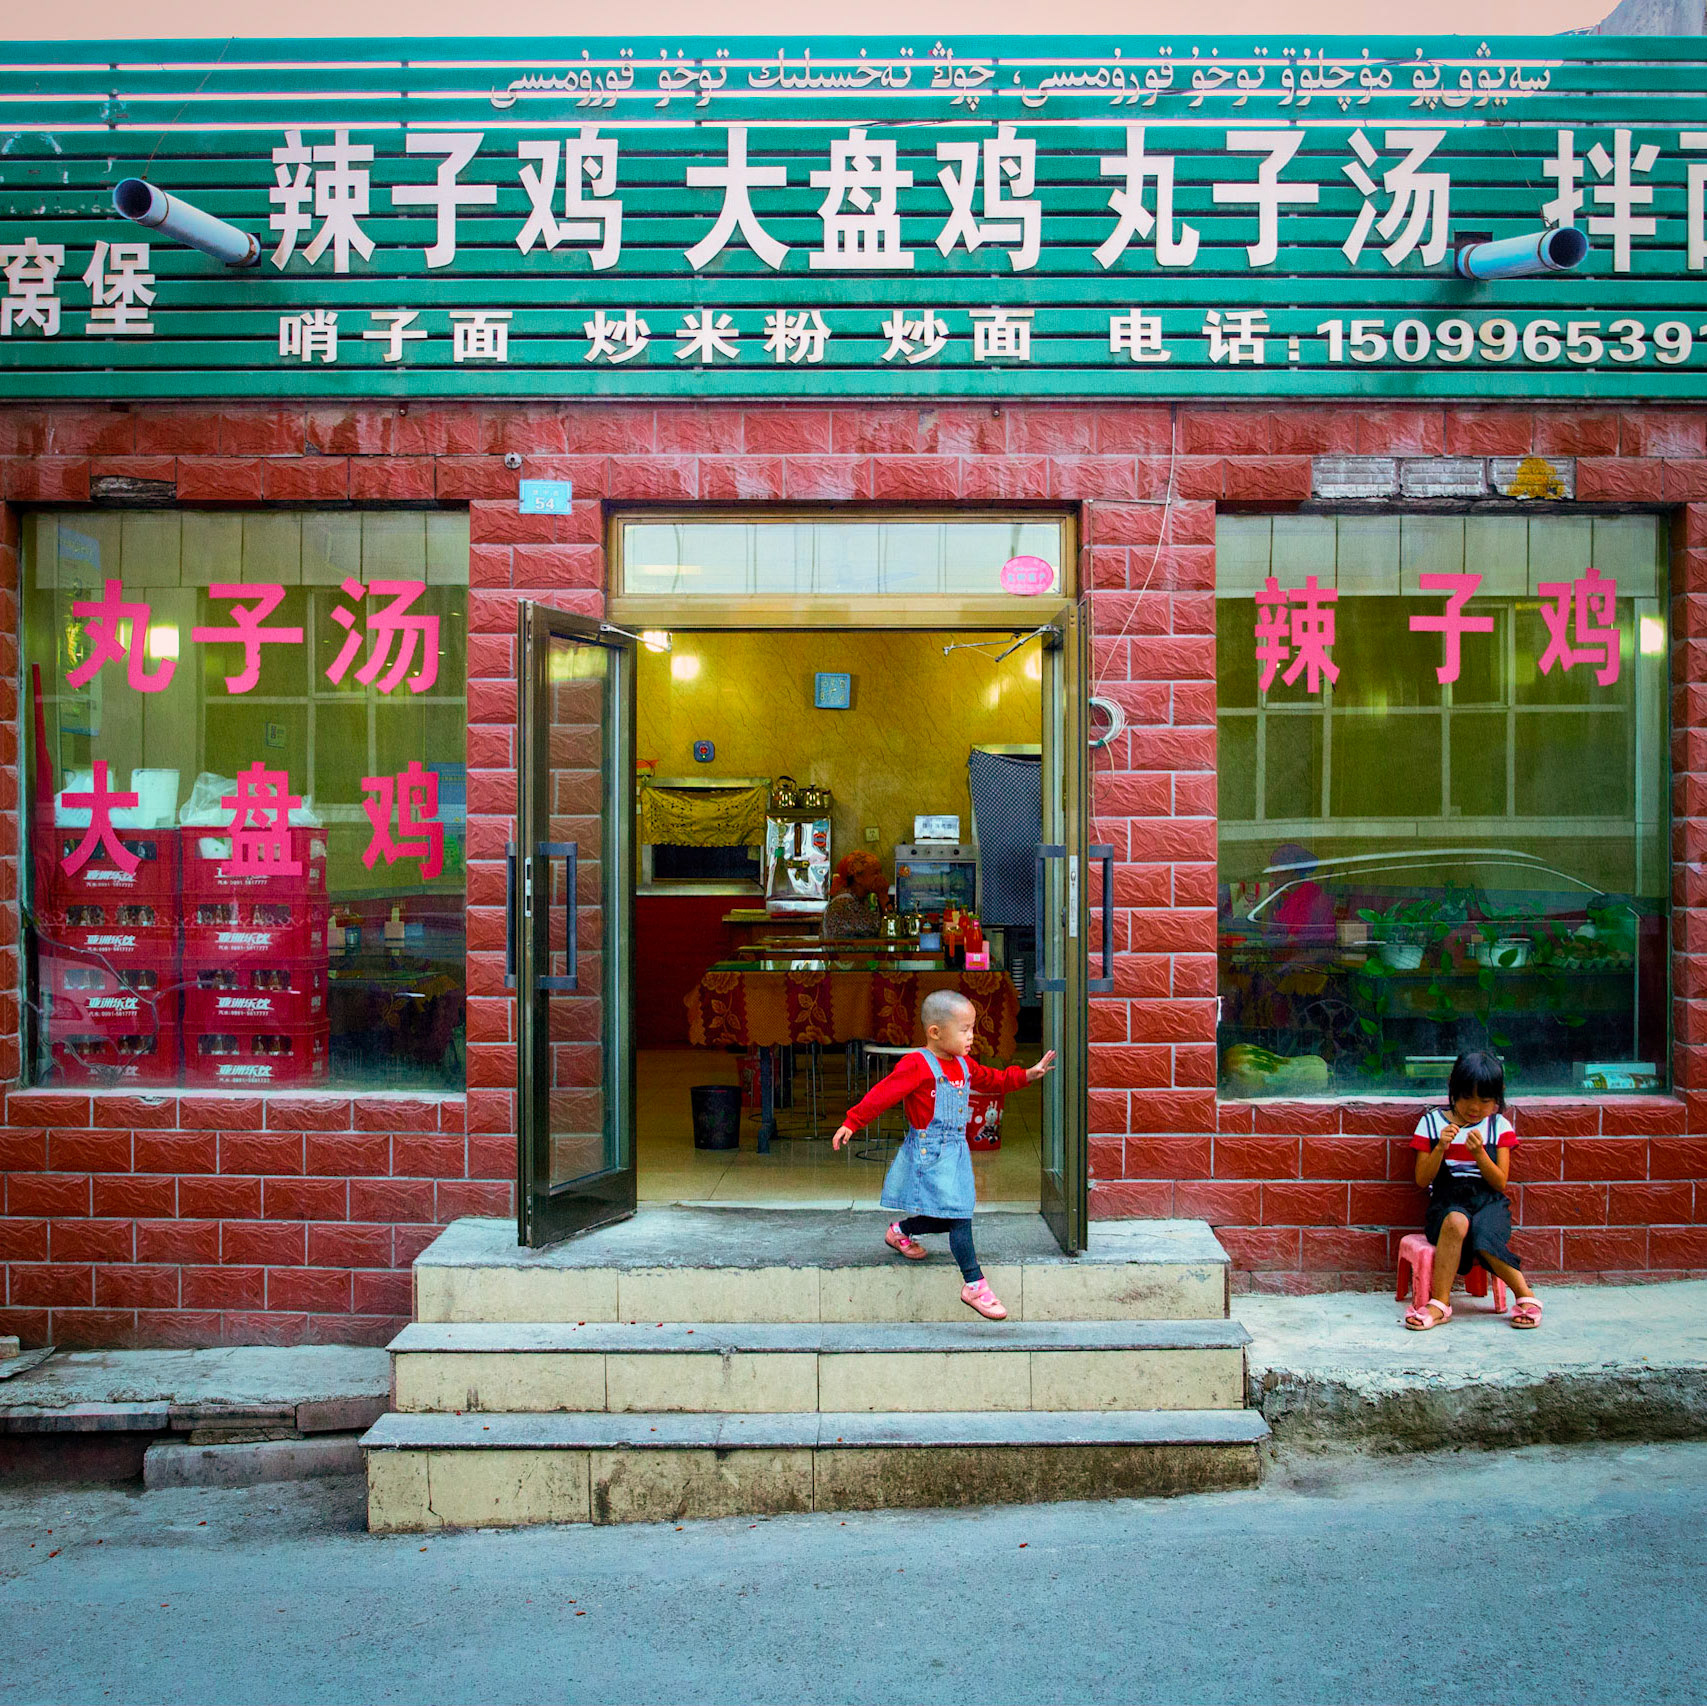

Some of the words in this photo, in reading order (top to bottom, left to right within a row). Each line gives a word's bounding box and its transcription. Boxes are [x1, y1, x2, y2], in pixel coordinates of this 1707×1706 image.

[269, 126, 622, 272] 辣子鸡
[684, 127, 1042, 272] 大盘鸡
[1092, 127, 1450, 271] 丸子汤
[1543, 129, 1707, 272] 拌
[0, 237, 157, 336] 窝堡
[280, 309, 513, 364] 哨子面
[583, 308, 832, 364] 炒米粉
[882, 308, 1034, 364] 炒面
[535, 496, 555, 511] 54
[66, 577, 440, 694] 丸子汤
[1255, 567, 1621, 693] 辣子鸡
[60, 761, 443, 879] 大盘鸡
